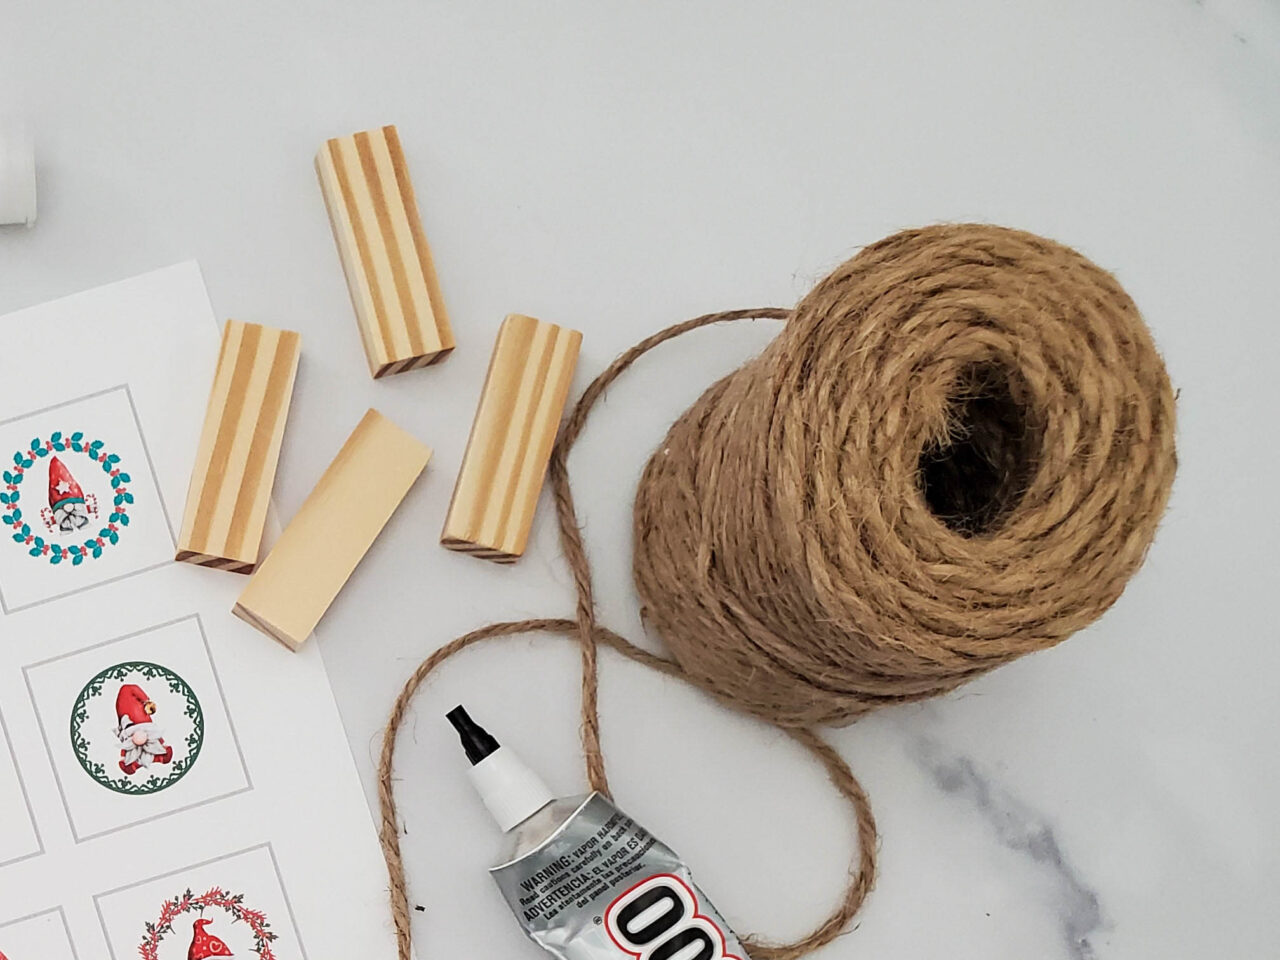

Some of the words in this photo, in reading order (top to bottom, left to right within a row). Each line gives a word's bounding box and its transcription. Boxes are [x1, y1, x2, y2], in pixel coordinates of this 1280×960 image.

[520, 854, 575, 893] WARNING:
[573, 836, 600, 859] VAPOR
[523, 872, 595, 922] ADVERTENCIA:
[592, 862, 604, 876] EL
[604, 846, 629, 870] VAPOR
[626, 837, 639, 851] ES
[539, 871, 571, 894] cautions
[572, 849, 604, 874] carefully
[543, 907, 559, 921] Lea
[600, 866, 615, 883] las
[577, 894, 590, 909] del
[590, 884, 610, 902] panel
